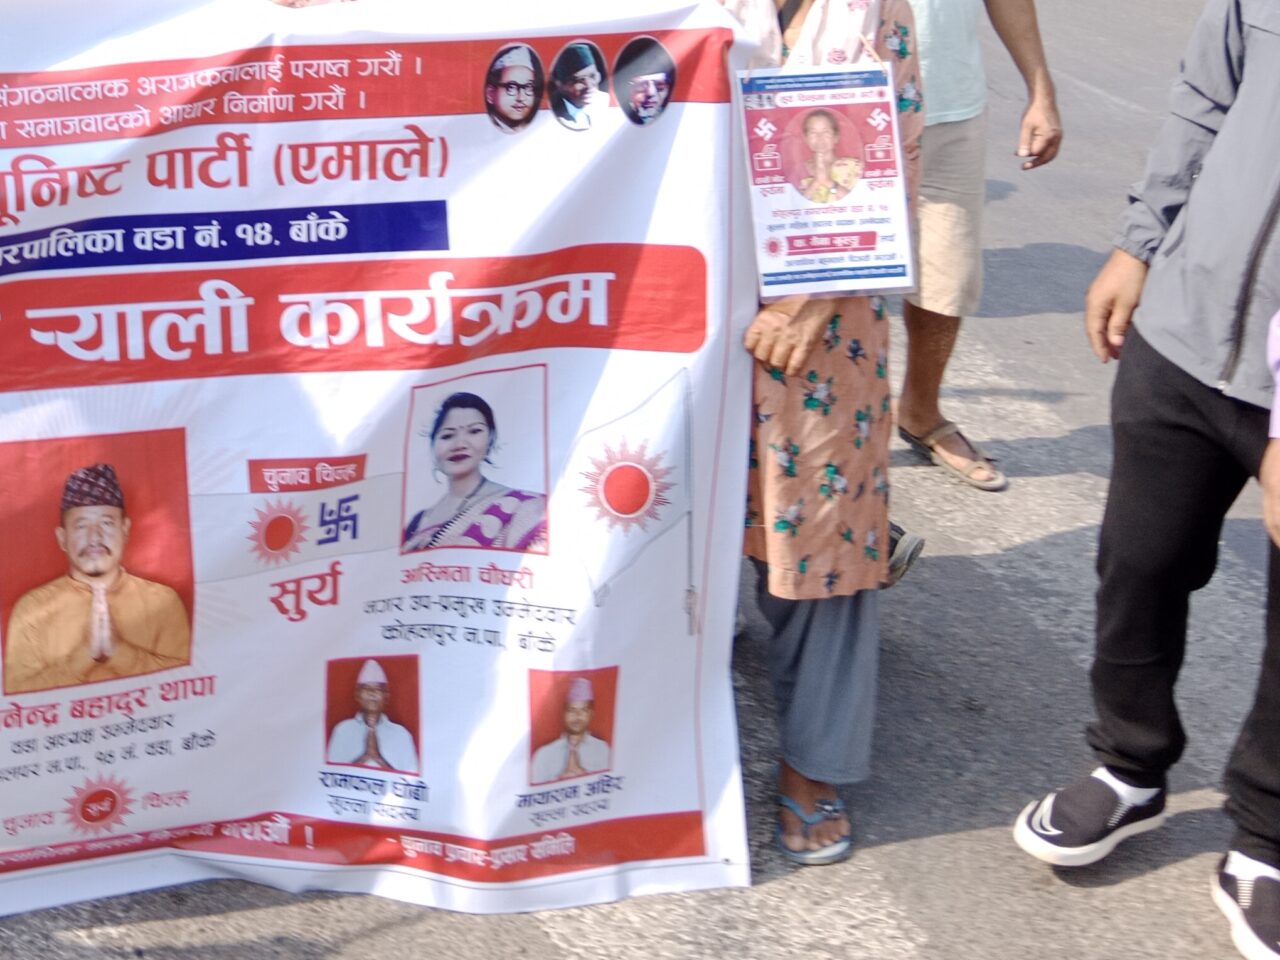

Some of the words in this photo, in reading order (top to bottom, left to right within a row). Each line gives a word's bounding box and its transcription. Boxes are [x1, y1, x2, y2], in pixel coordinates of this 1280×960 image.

[14, 104, 151, 140] समाजवादको
[146, 131, 254, 190] पार्टी
[273, 124, 450, 189] (एमाले)
[133, 226, 187, 252] वडा
[288, 211, 350, 243] बाँके
[278, 270, 617, 348] कार्यक्रम
[261, 467, 312, 492] चुनाव
[159, 675, 218, 702] थापा
